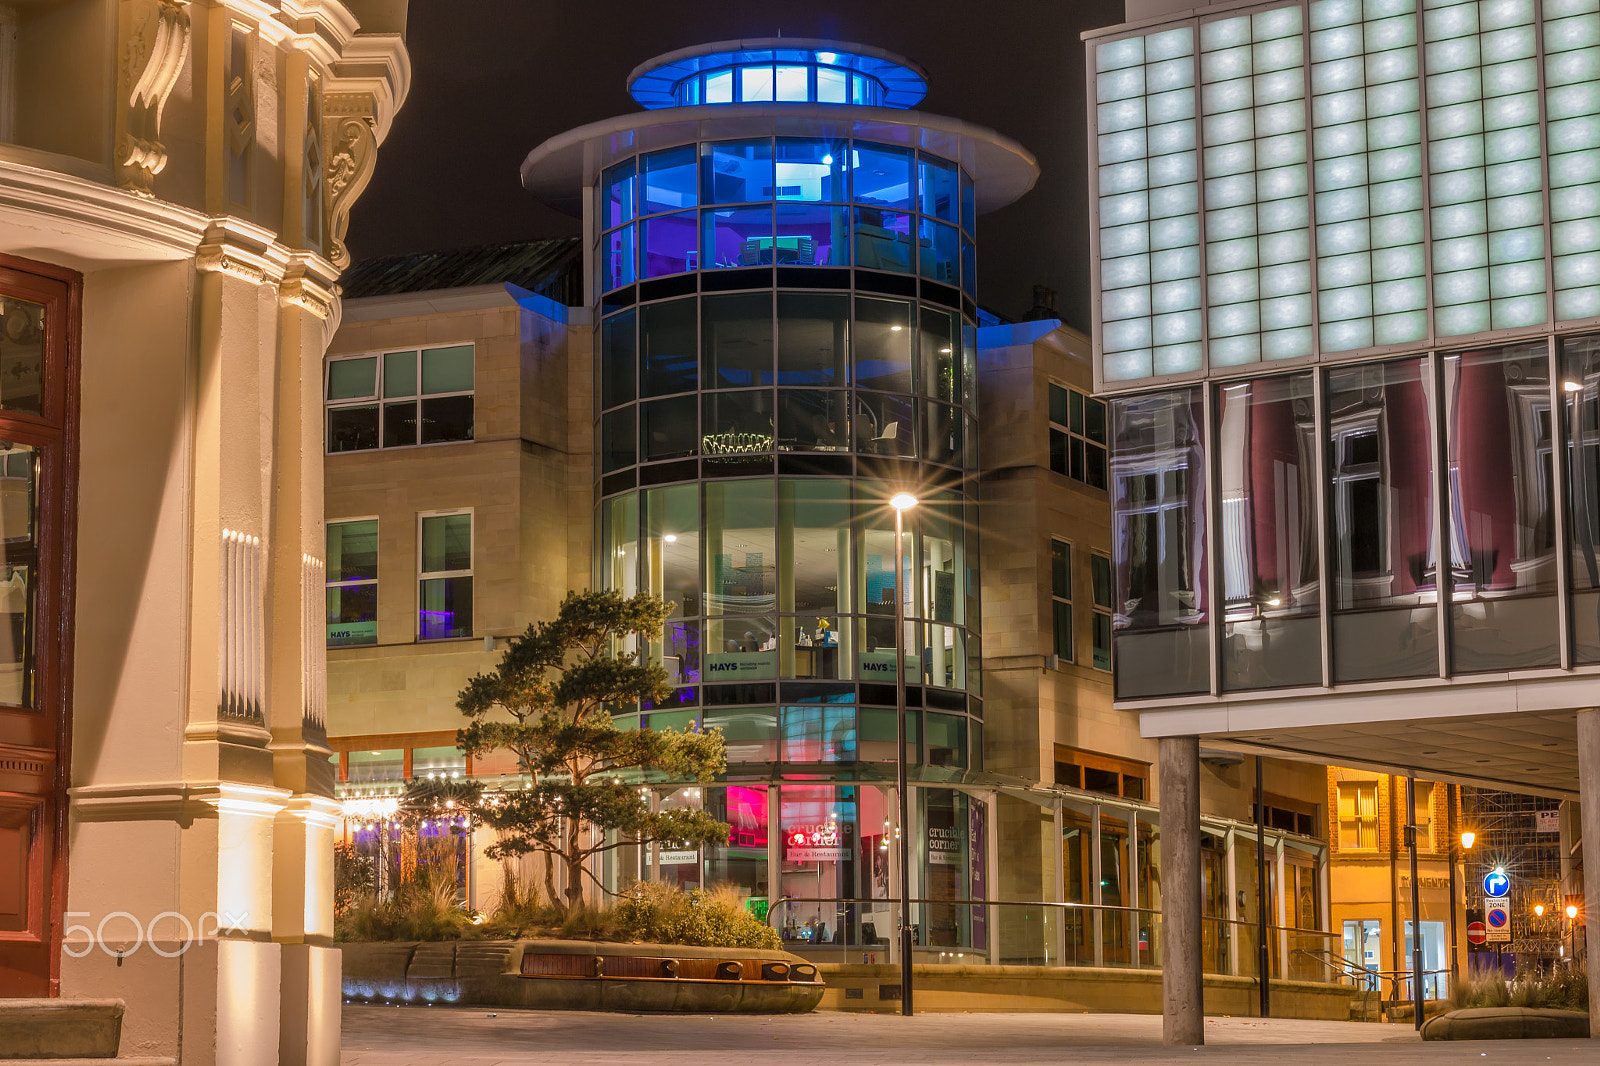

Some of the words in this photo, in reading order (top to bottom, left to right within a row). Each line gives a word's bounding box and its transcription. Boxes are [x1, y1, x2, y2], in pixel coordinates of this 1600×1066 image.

[330, 630, 351, 638] HAYS
[710, 662, 738, 672] HAYS
[863, 662, 888, 672] HAYS
[929, 826, 965, 839] crucible
[929, 839, 959, 850] corner
